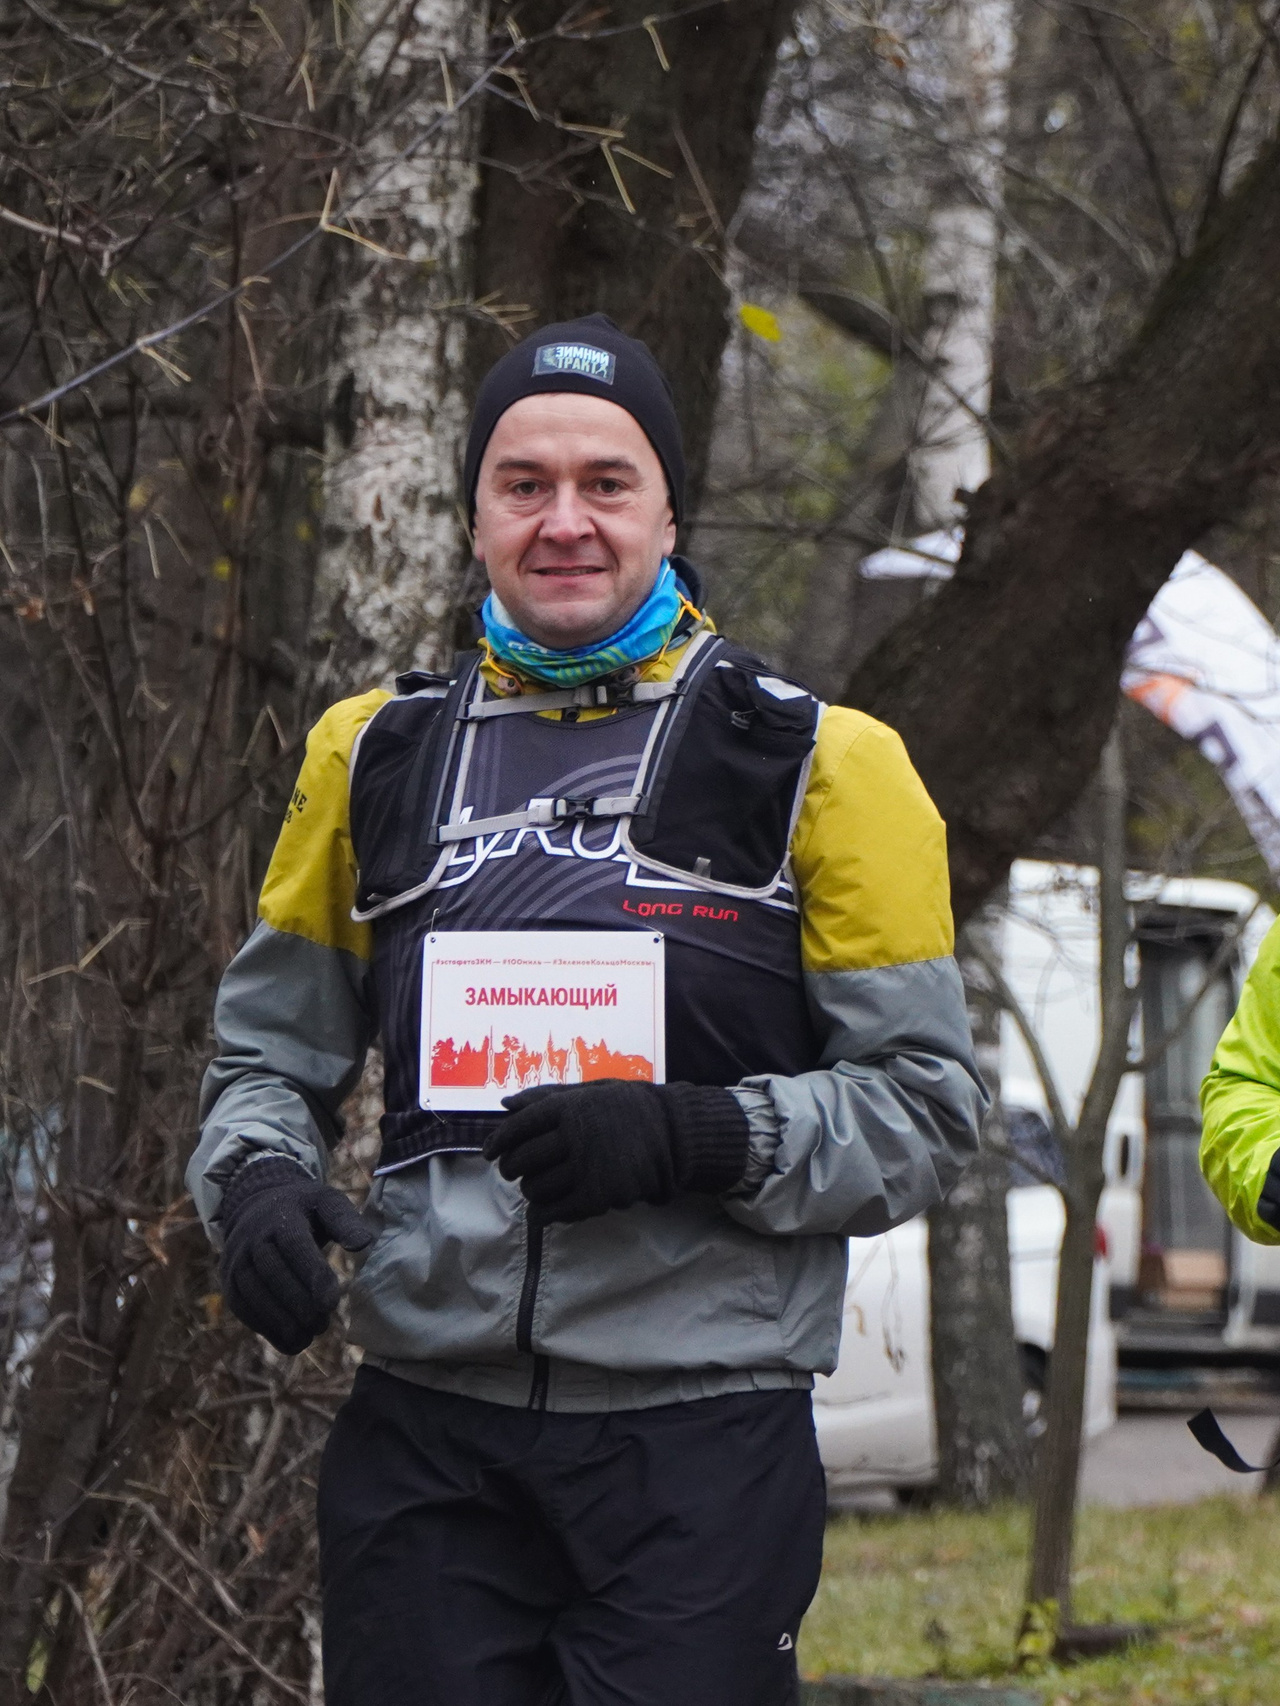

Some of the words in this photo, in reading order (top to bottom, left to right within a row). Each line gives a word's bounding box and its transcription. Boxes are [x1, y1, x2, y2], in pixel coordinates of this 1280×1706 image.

[555, 346, 610, 367] ЗИМНИЙ
[556, 357, 599, 375] ТРАКТ
[464, 983, 618, 1011] ЗАМЫКАЮЩИЙ
